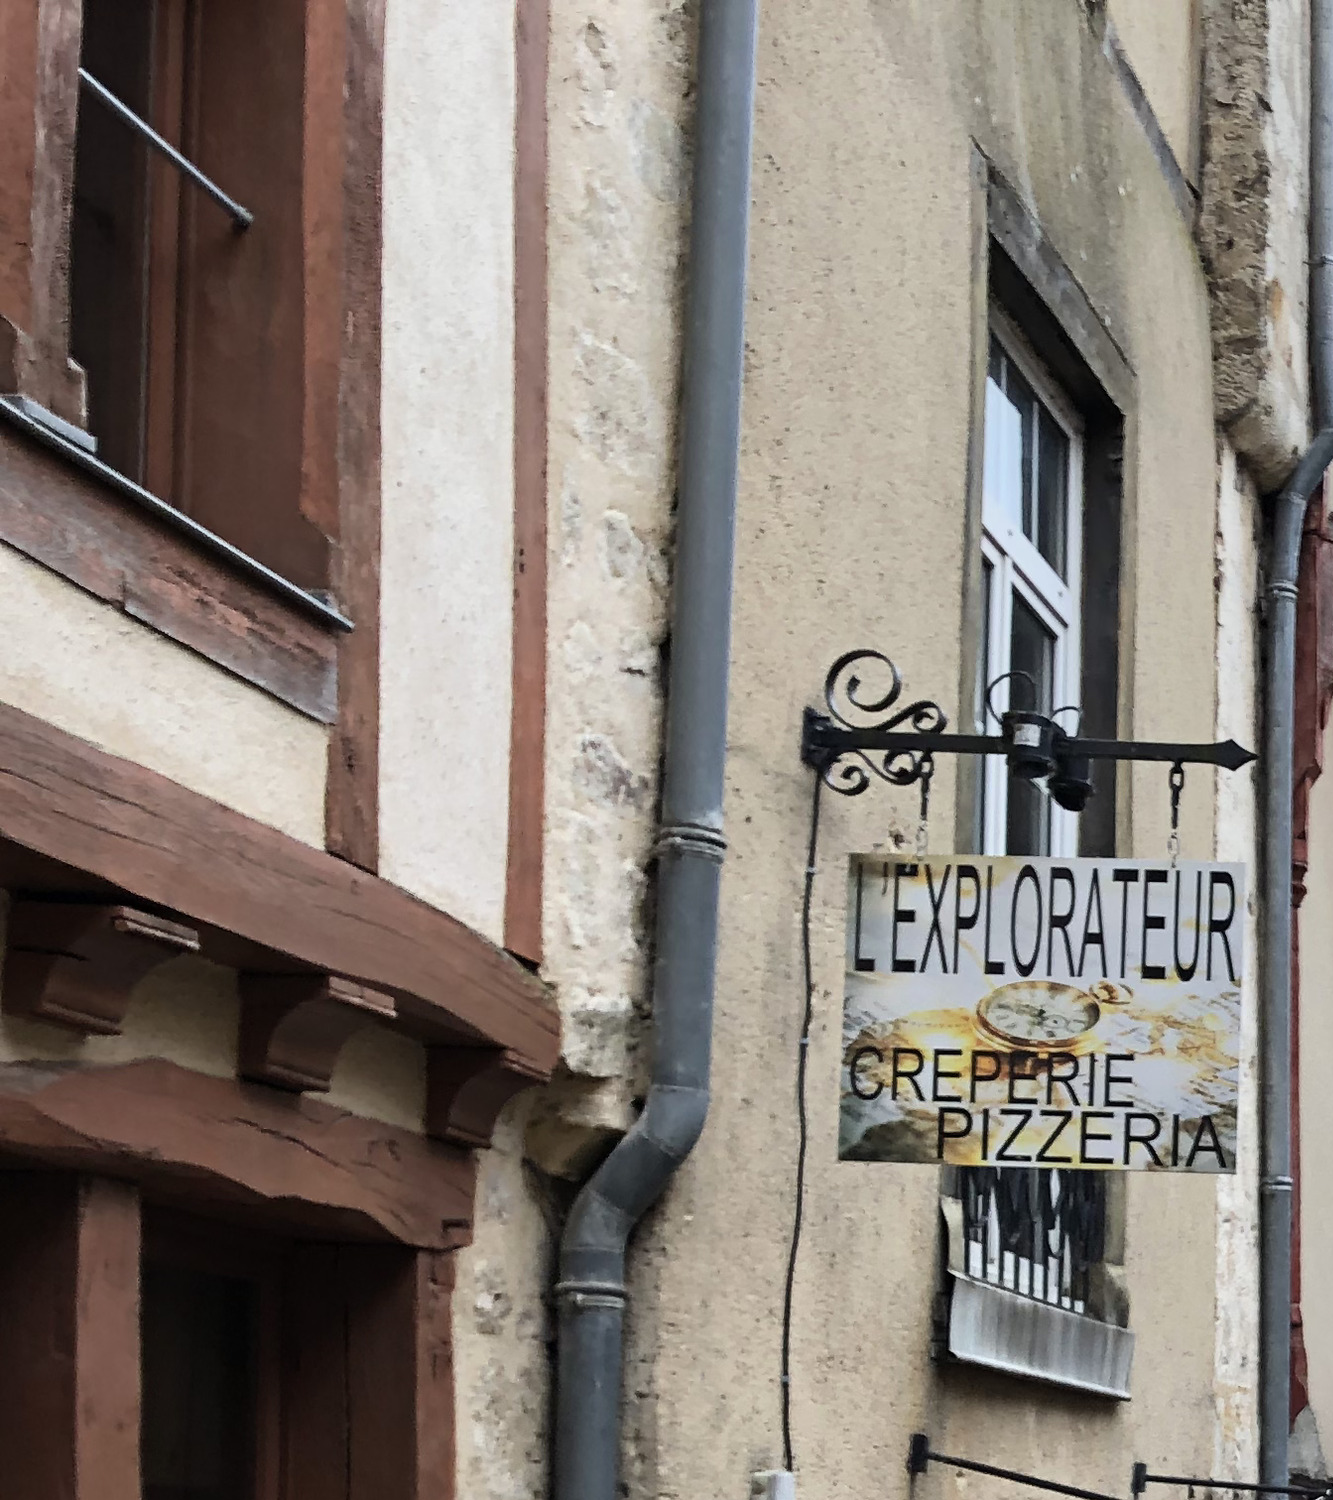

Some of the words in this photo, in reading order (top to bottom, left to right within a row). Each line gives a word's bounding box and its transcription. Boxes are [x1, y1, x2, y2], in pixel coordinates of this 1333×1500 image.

[853, 863, 1236, 982] L'EXPLORATEUR
[849, 1047, 1135, 1108] CREPERIE
[937, 1108, 1228, 1169] PIZZERIA
